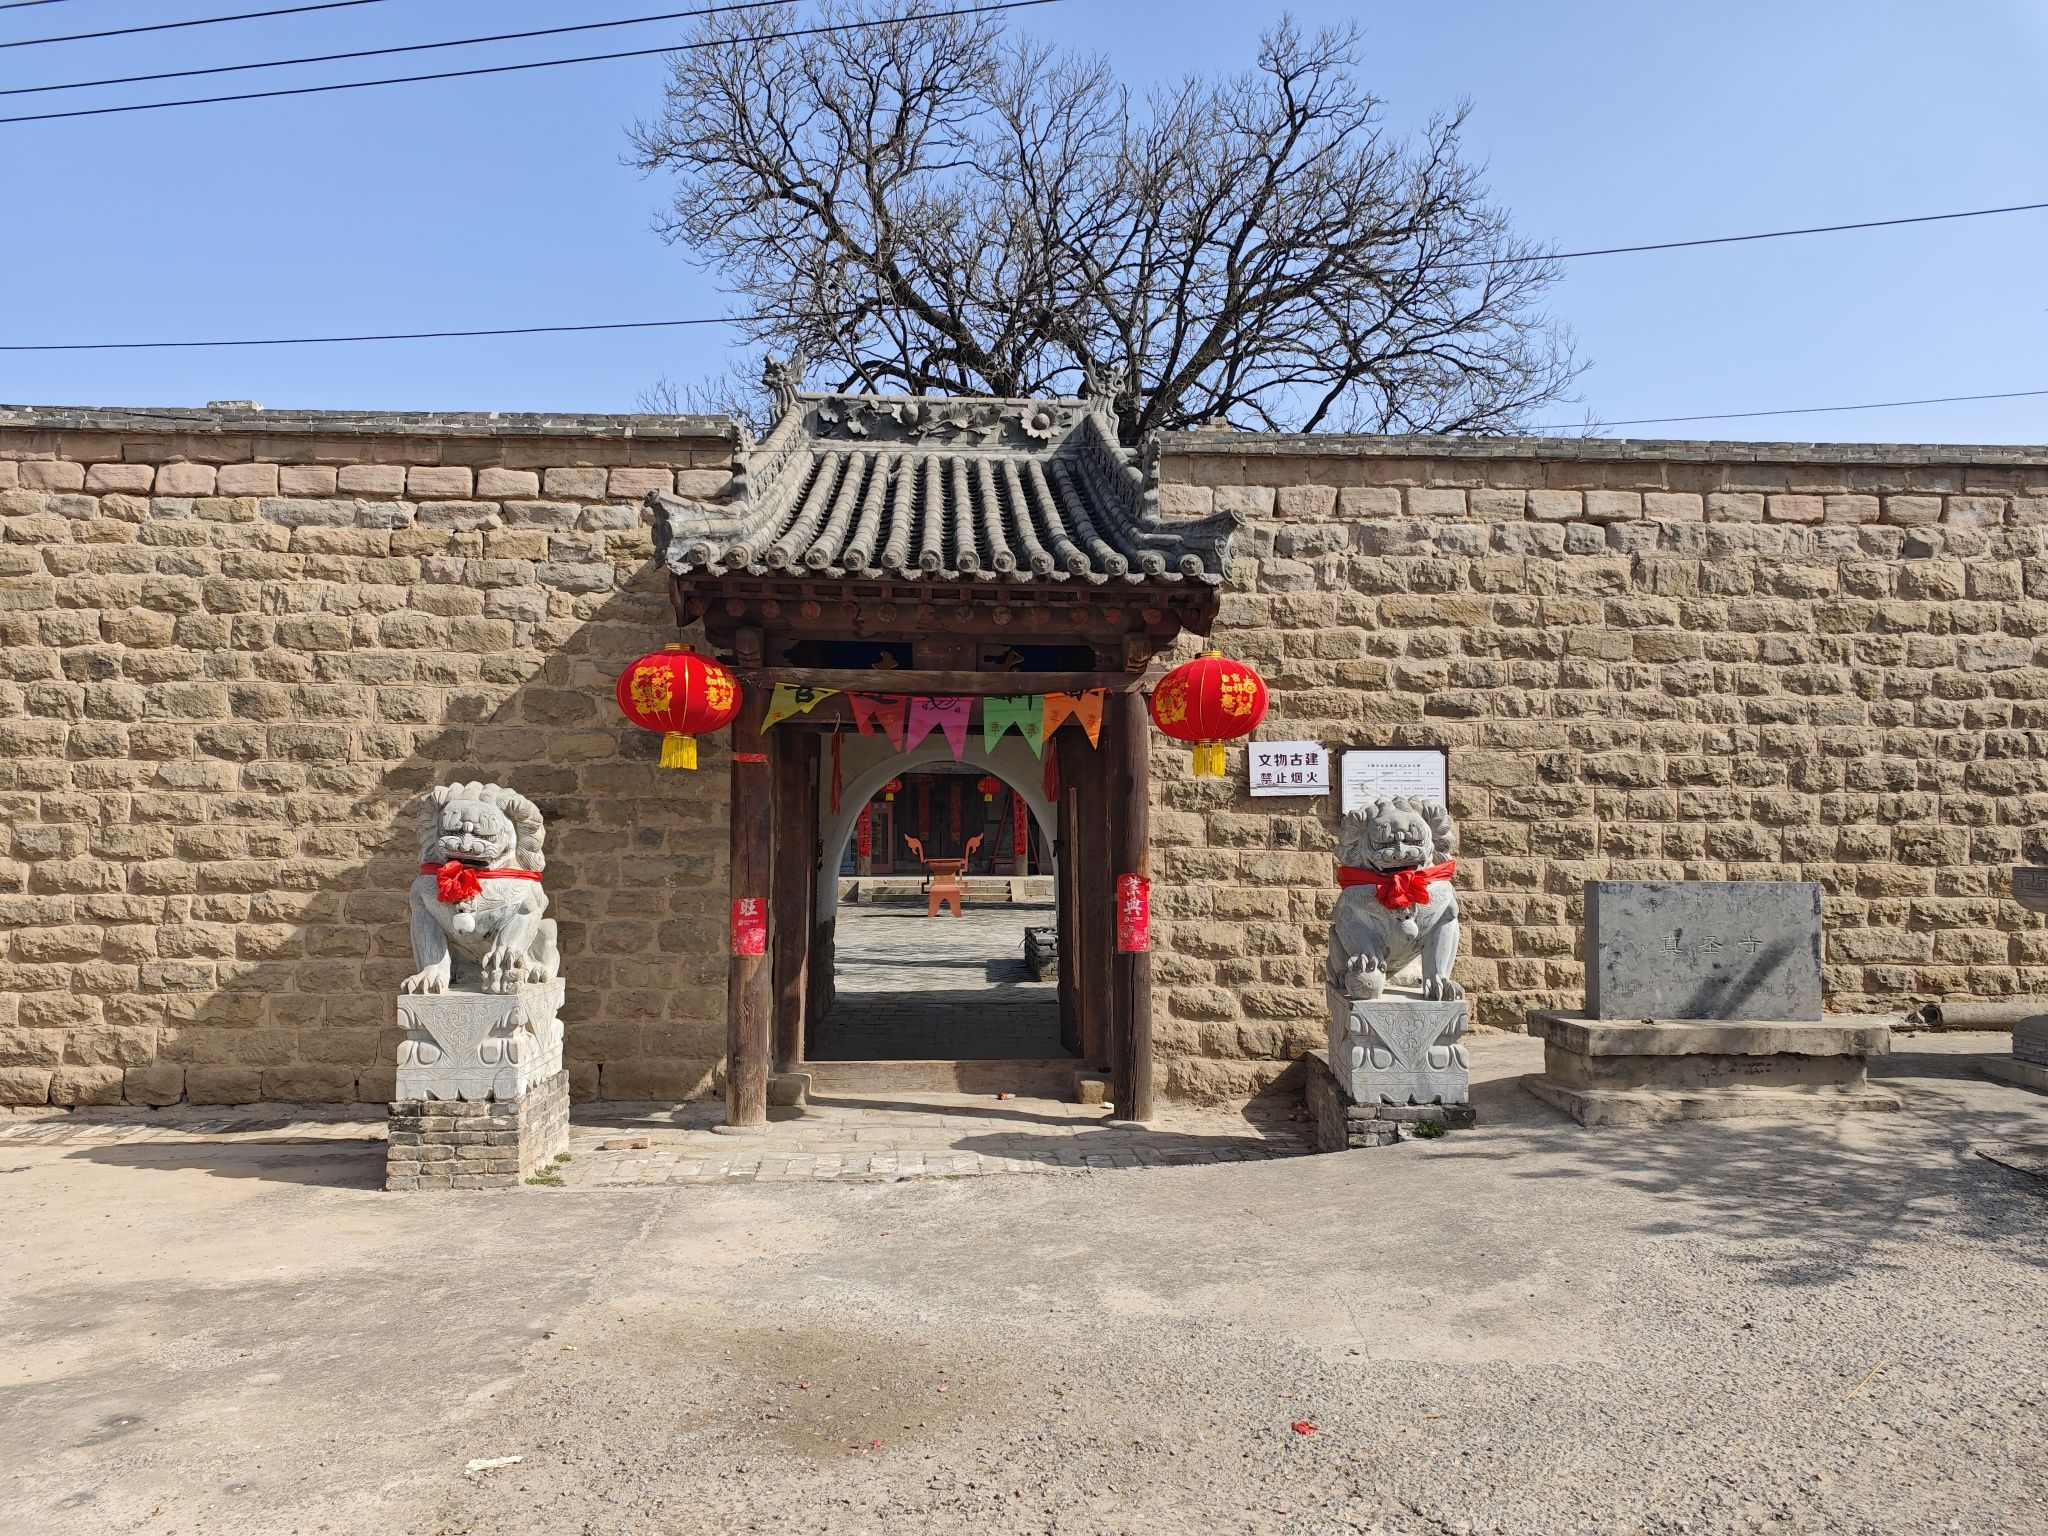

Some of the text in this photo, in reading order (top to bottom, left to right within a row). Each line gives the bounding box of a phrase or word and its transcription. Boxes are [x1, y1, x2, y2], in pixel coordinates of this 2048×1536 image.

[1258, 753, 1319, 767] 文物古建
[1260, 772, 1319, 785] 禁止烟火
